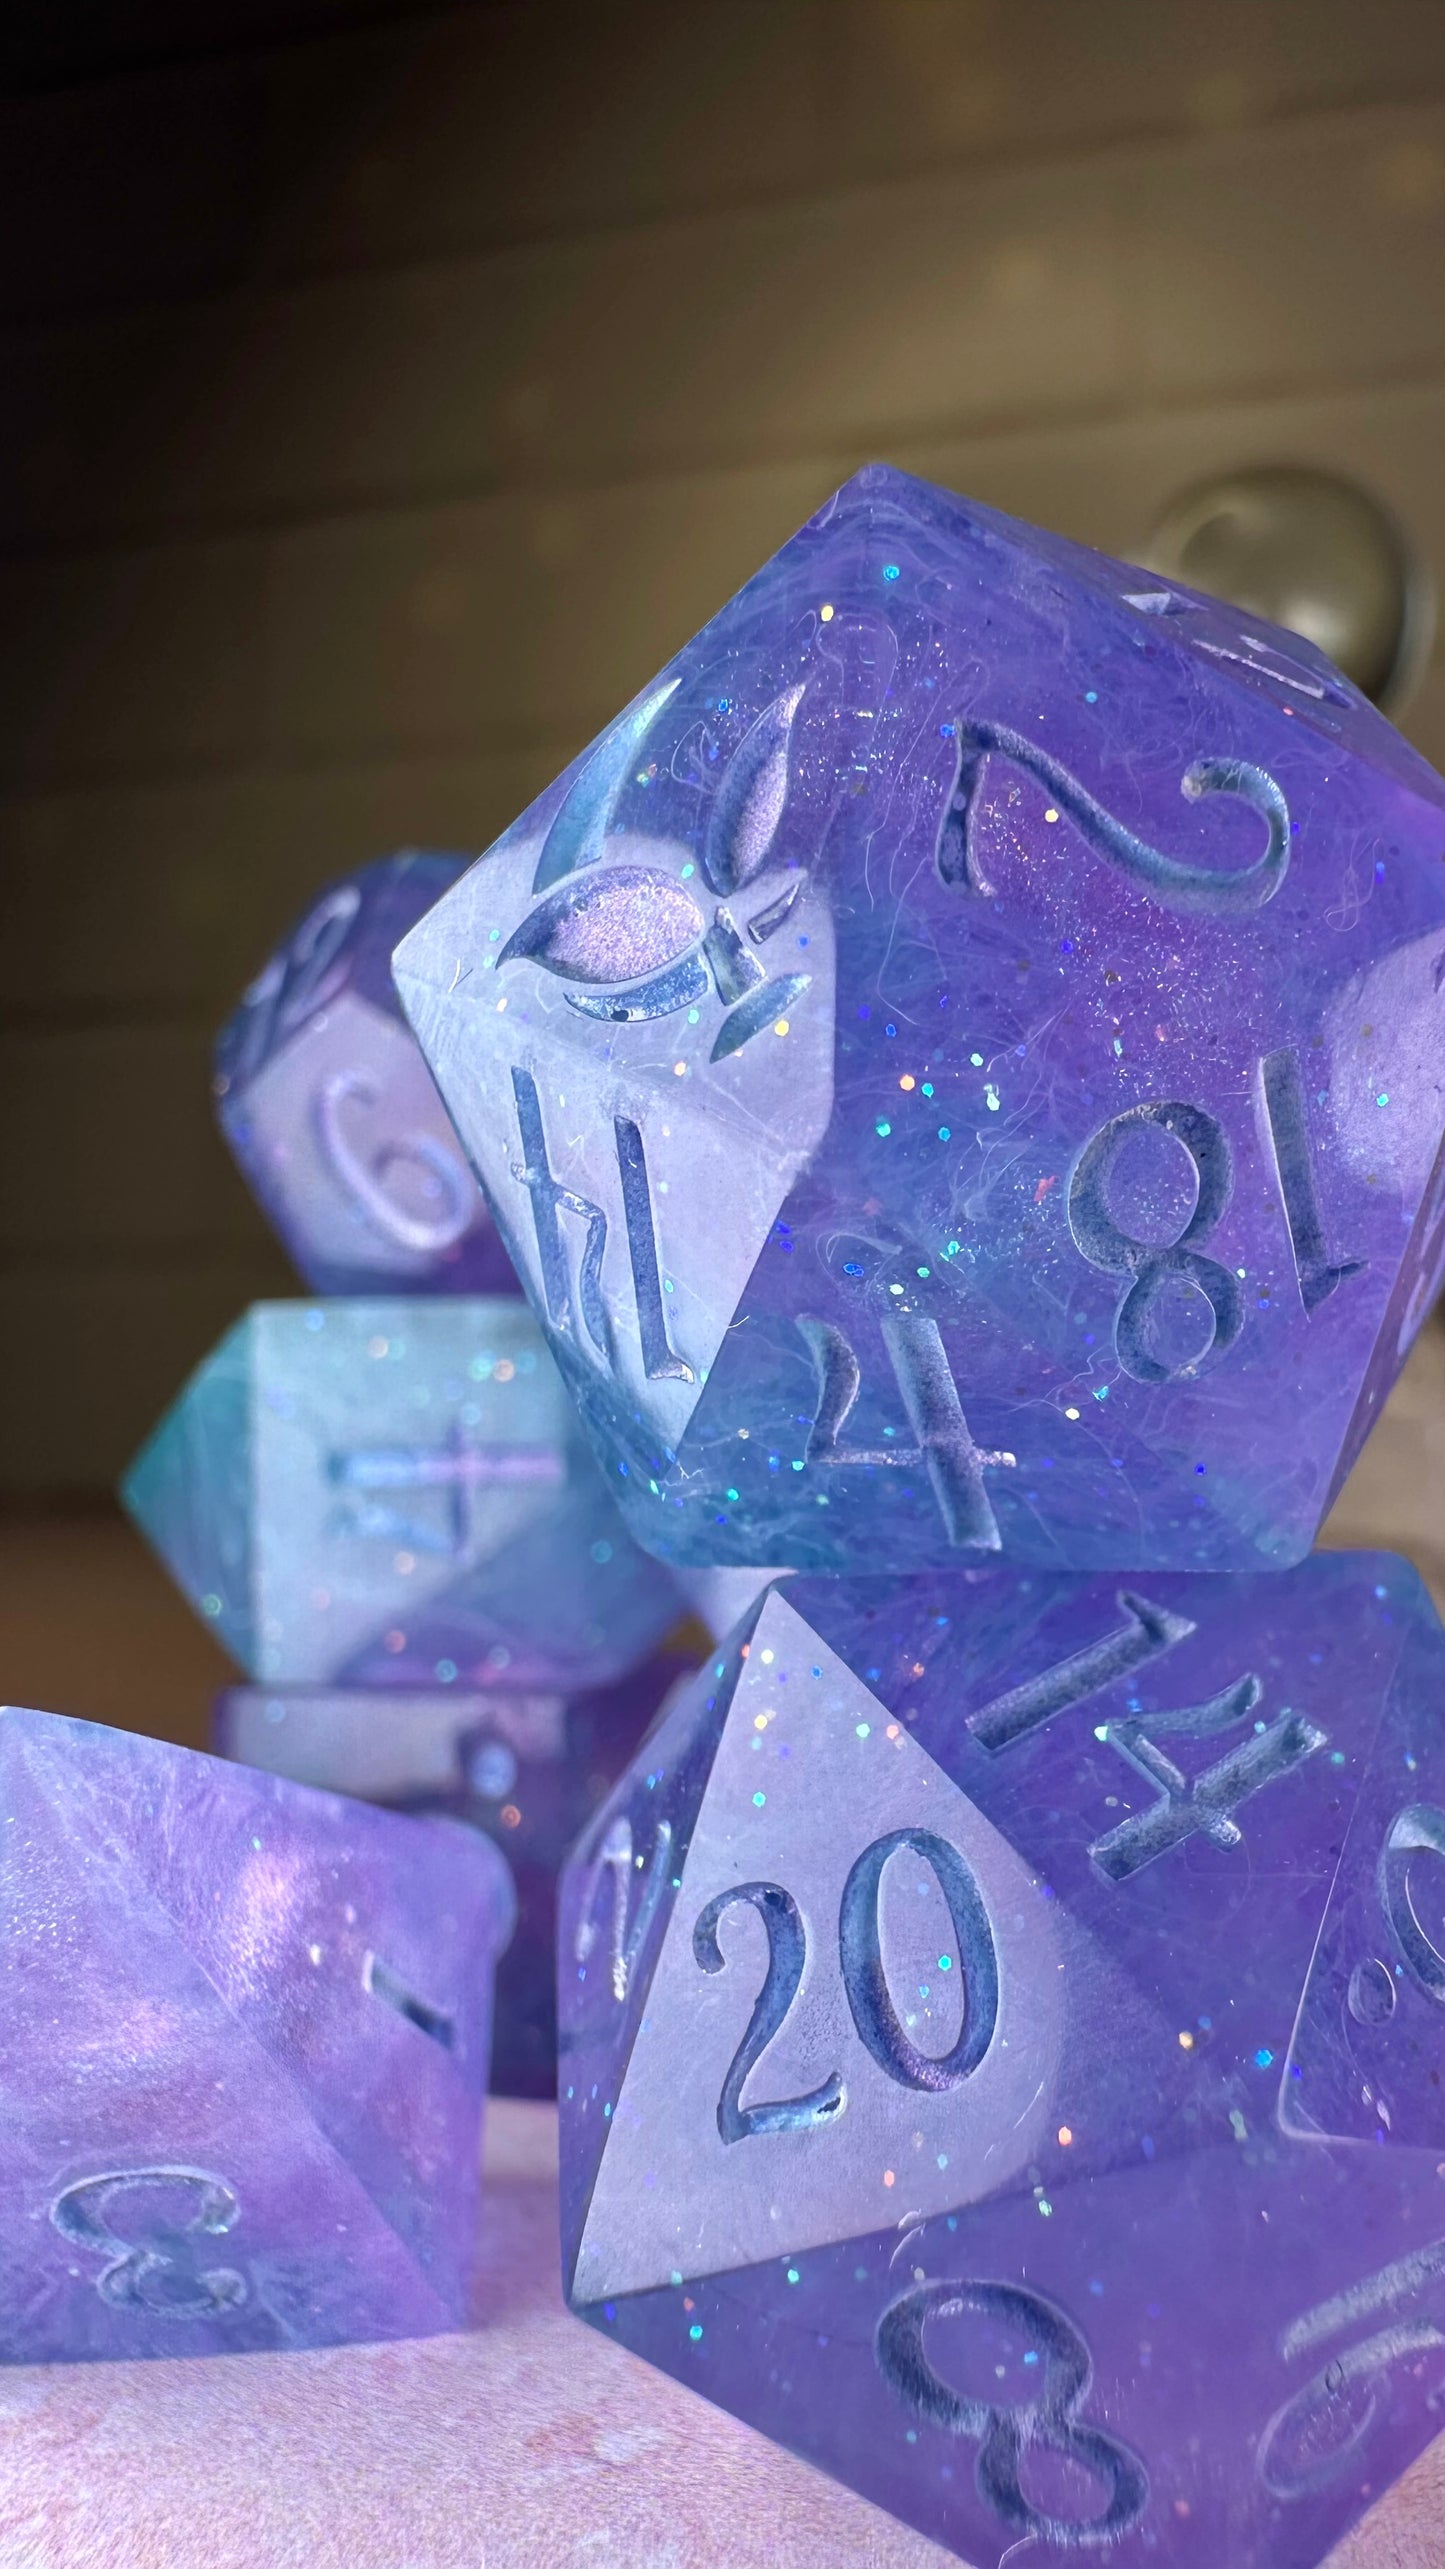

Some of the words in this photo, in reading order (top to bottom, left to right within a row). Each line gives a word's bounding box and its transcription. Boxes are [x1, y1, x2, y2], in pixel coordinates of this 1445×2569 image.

[934, 716, 1292, 914] 2
[1068, 1044, 1372, 1386] 18
[794, 1310, 1018, 1552] 4
[962, 1590, 1329, 1884] 14
[692, 1826, 1002, 2146] 20
[874, 2277, 1151, 2549] 8
